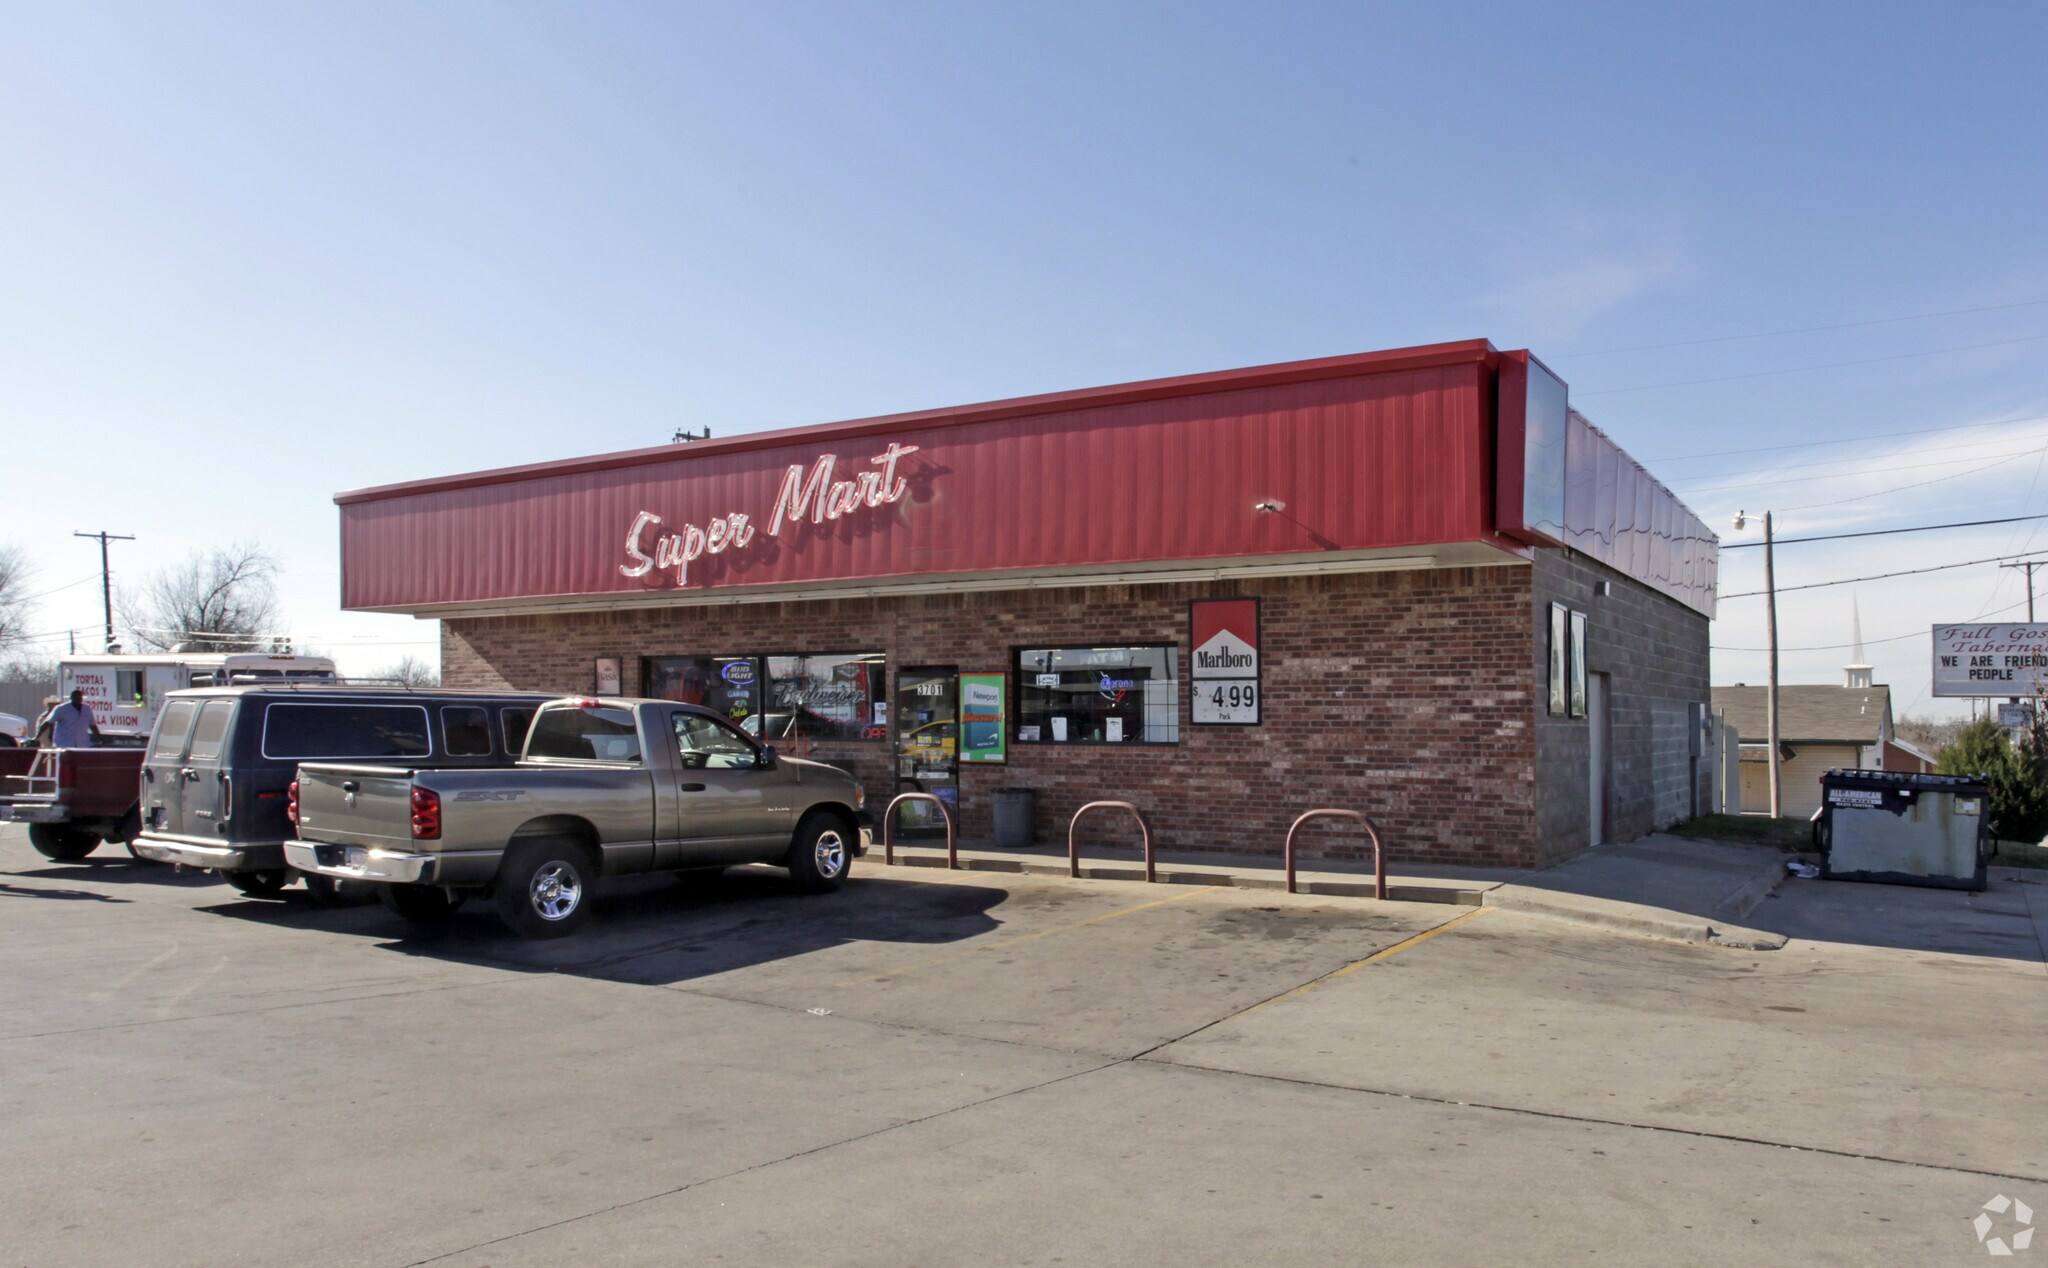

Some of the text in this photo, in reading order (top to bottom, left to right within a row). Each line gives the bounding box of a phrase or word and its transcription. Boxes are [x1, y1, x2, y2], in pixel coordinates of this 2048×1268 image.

[620, 442, 919, 586] Super Mart
[1942, 627, 2048, 642] Full Gos
[1087, 651, 1123, 665] ATM
[1197, 646, 1253, 668] Marlboro
[1941, 655, 1958, 667] WE
[1970, 655, 1993, 667] ARE
[75, 675, 104, 685] TORTAS
[1969, 669, 2013, 680] PEOPLE
[102, 687, 107, 696] Y
[773, 682, 866, 706] Budweiser
[918, 685, 942, 695] 3701
[973, 691, 998, 703] Newport
[1212, 685, 1254, 708] 4.99
[96, 715, 138, 726] LA VISION
[1219, 712, 1231, 720] Pack
[452, 790, 526, 802] SXT
